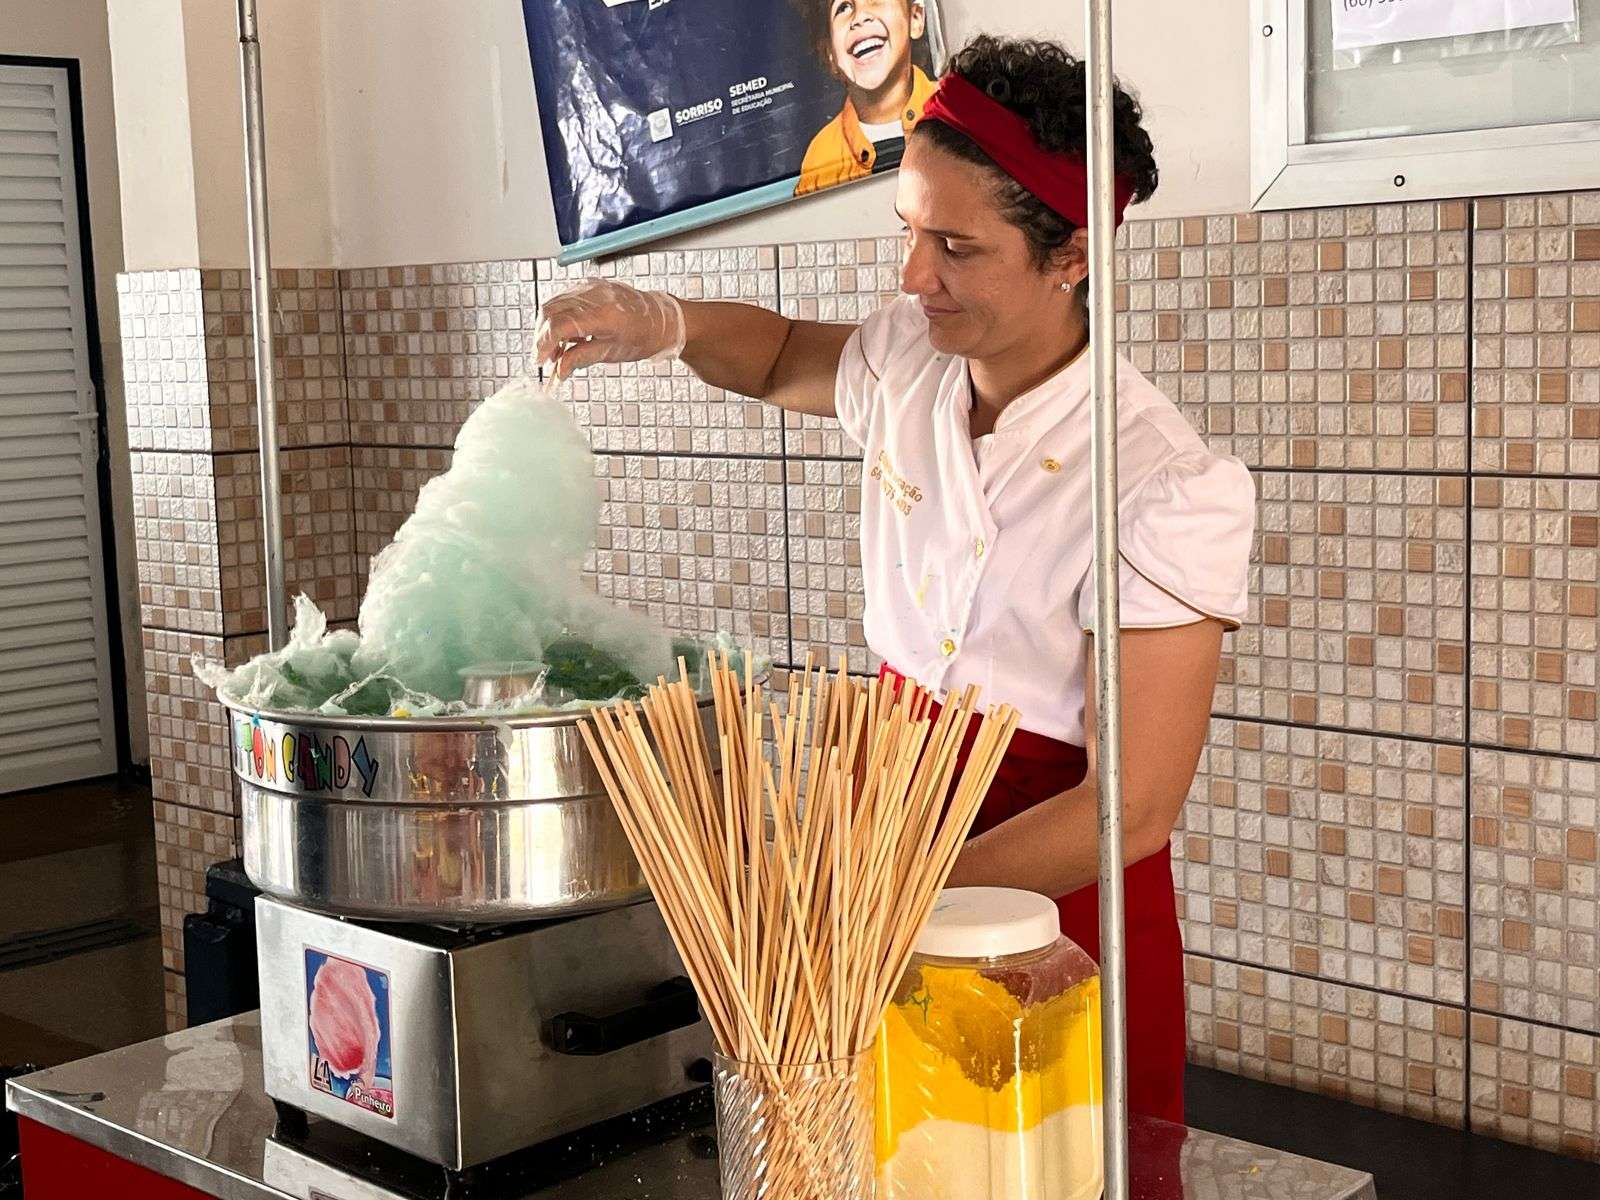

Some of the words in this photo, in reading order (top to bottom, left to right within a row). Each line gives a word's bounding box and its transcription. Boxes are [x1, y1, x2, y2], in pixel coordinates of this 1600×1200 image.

[729, 76, 767, 97] SEMED
[675, 98, 723, 123] SORRISO
[282, 732, 379, 797] CANDY
[355, 1087, 391, 1113] Pinheiro
